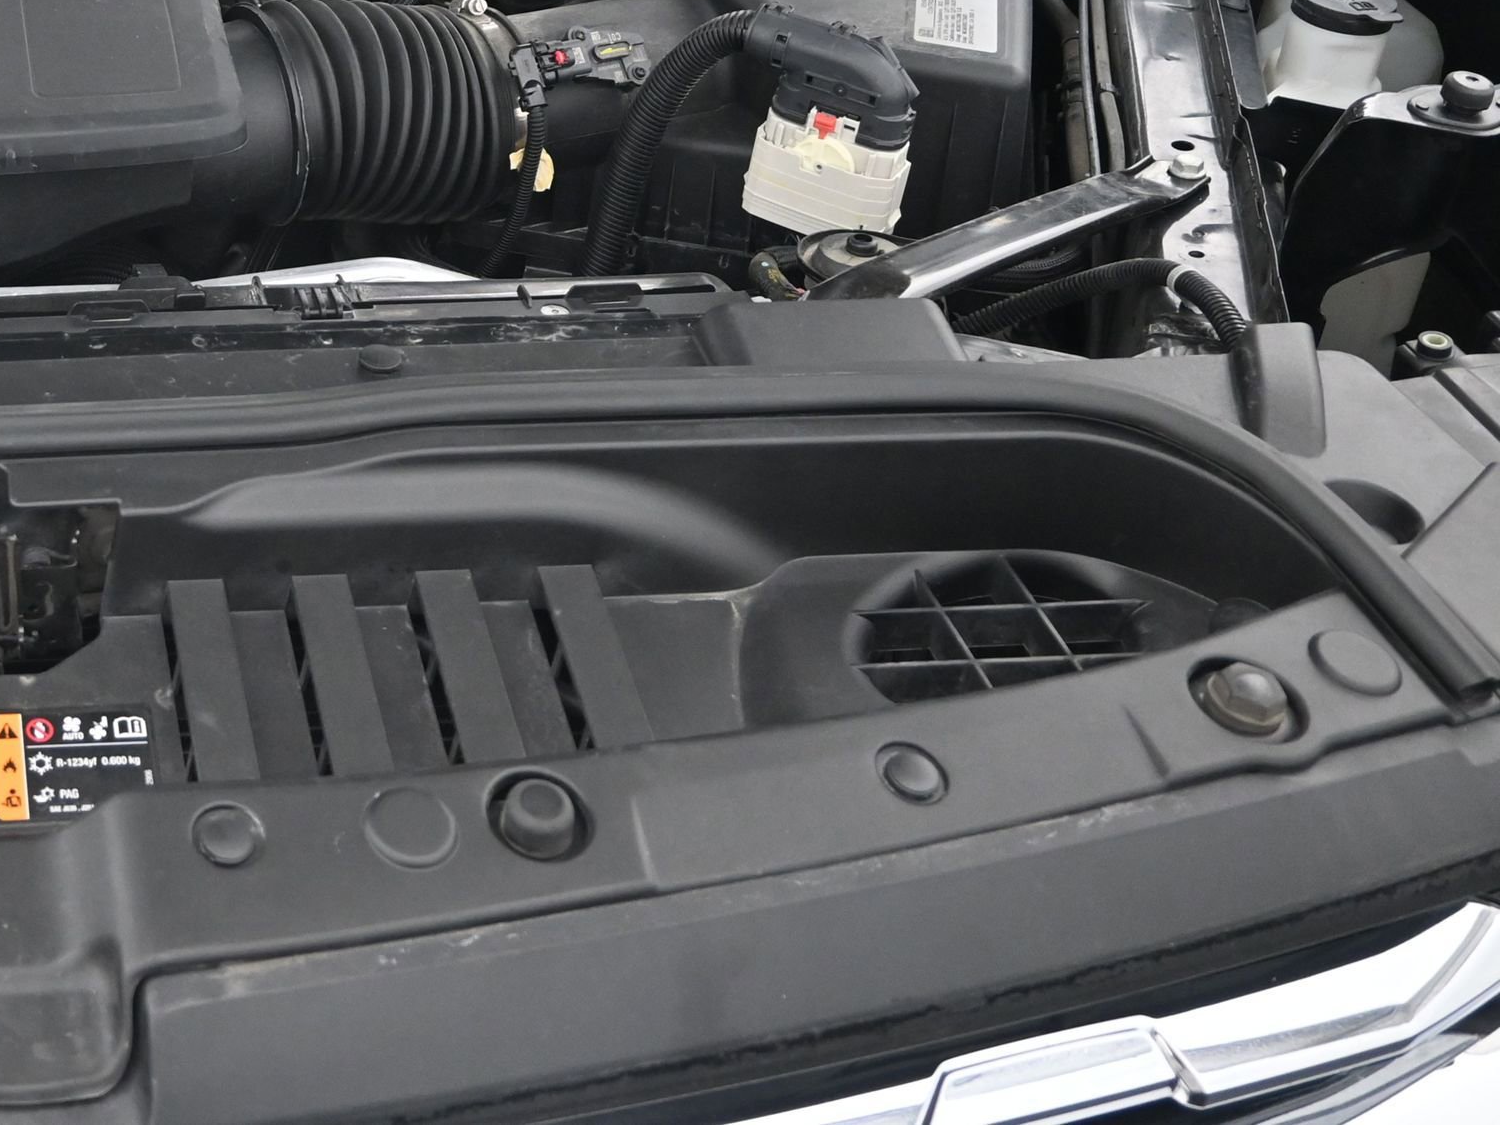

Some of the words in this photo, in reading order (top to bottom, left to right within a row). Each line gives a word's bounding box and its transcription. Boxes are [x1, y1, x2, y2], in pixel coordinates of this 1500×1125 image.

[62, 732, 84, 741] AUTO
[55, 757, 97, 768] R-1234yf
[128, 755, 141, 766] kg
[59, 788, 80, 799] PAG
